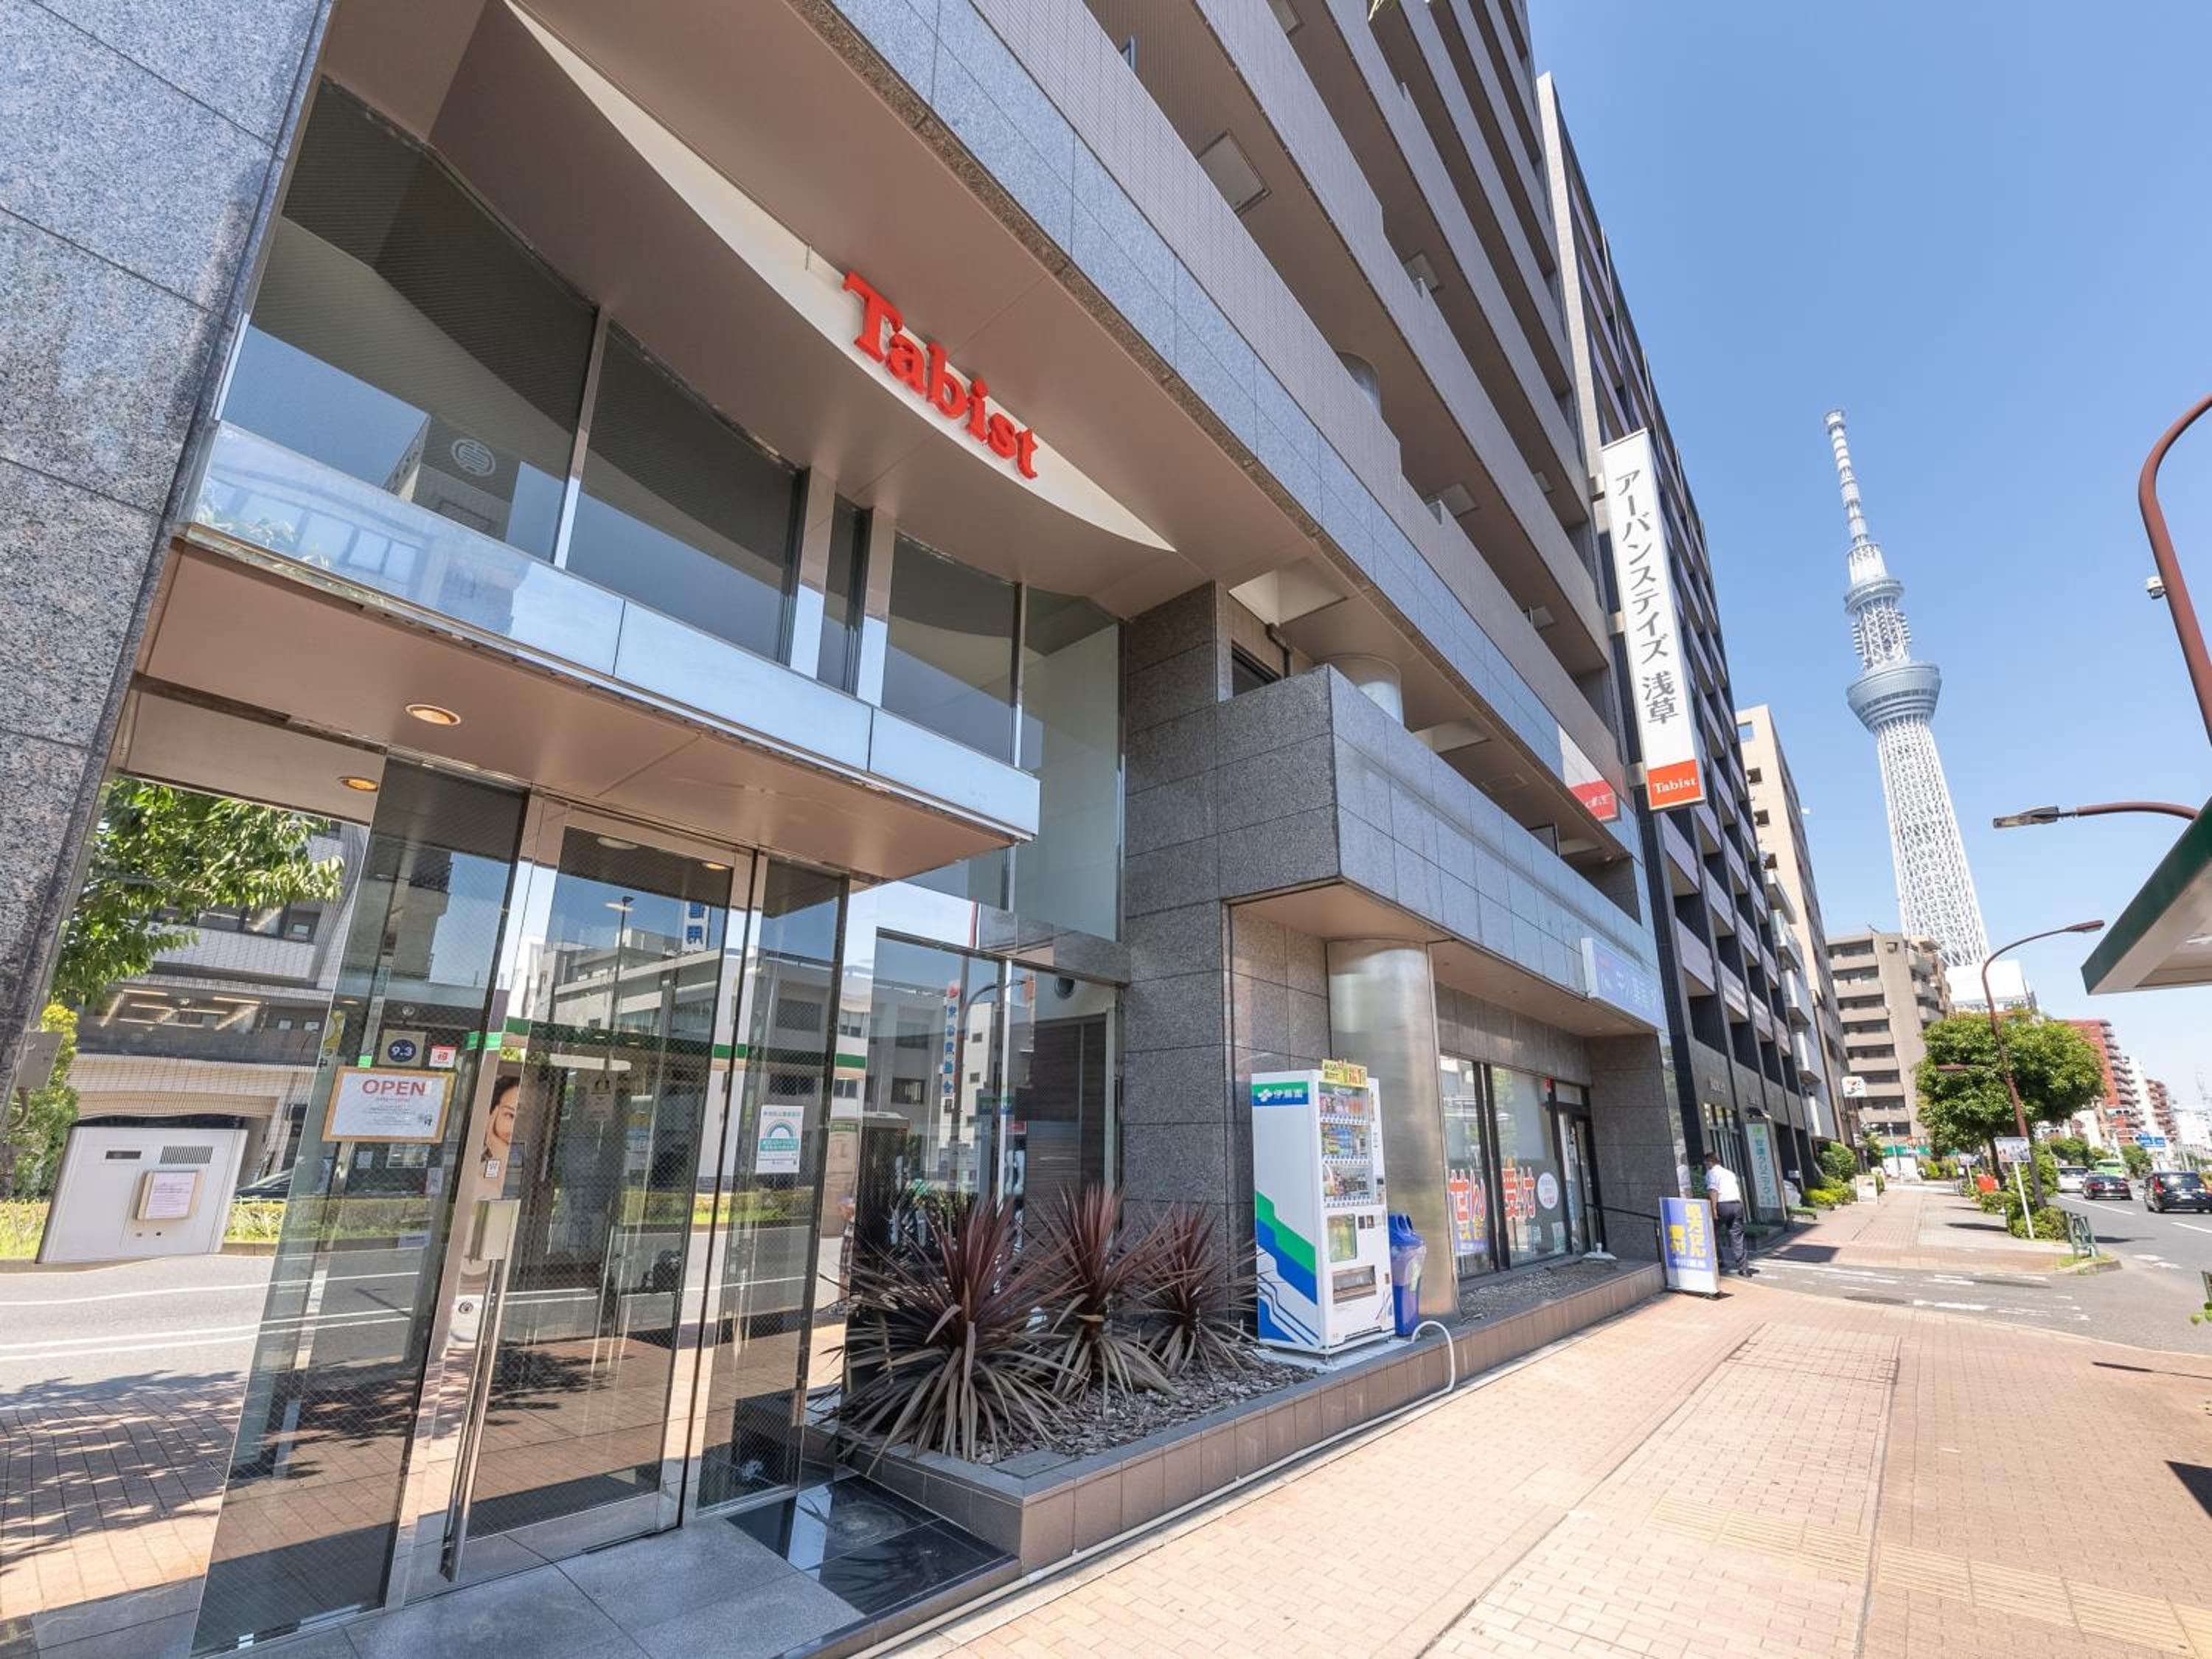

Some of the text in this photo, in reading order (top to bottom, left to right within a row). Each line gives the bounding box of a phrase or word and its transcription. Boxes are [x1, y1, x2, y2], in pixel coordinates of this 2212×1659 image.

[842, 271, 1039, 480] Tabist
[1615, 468, 1680, 725] アーバンステイズ 浅草
[1652, 778, 1697, 794] Tabist
[391, 1046, 413, 1057] 9.3
[362, 1079, 425, 1096] OPEN
